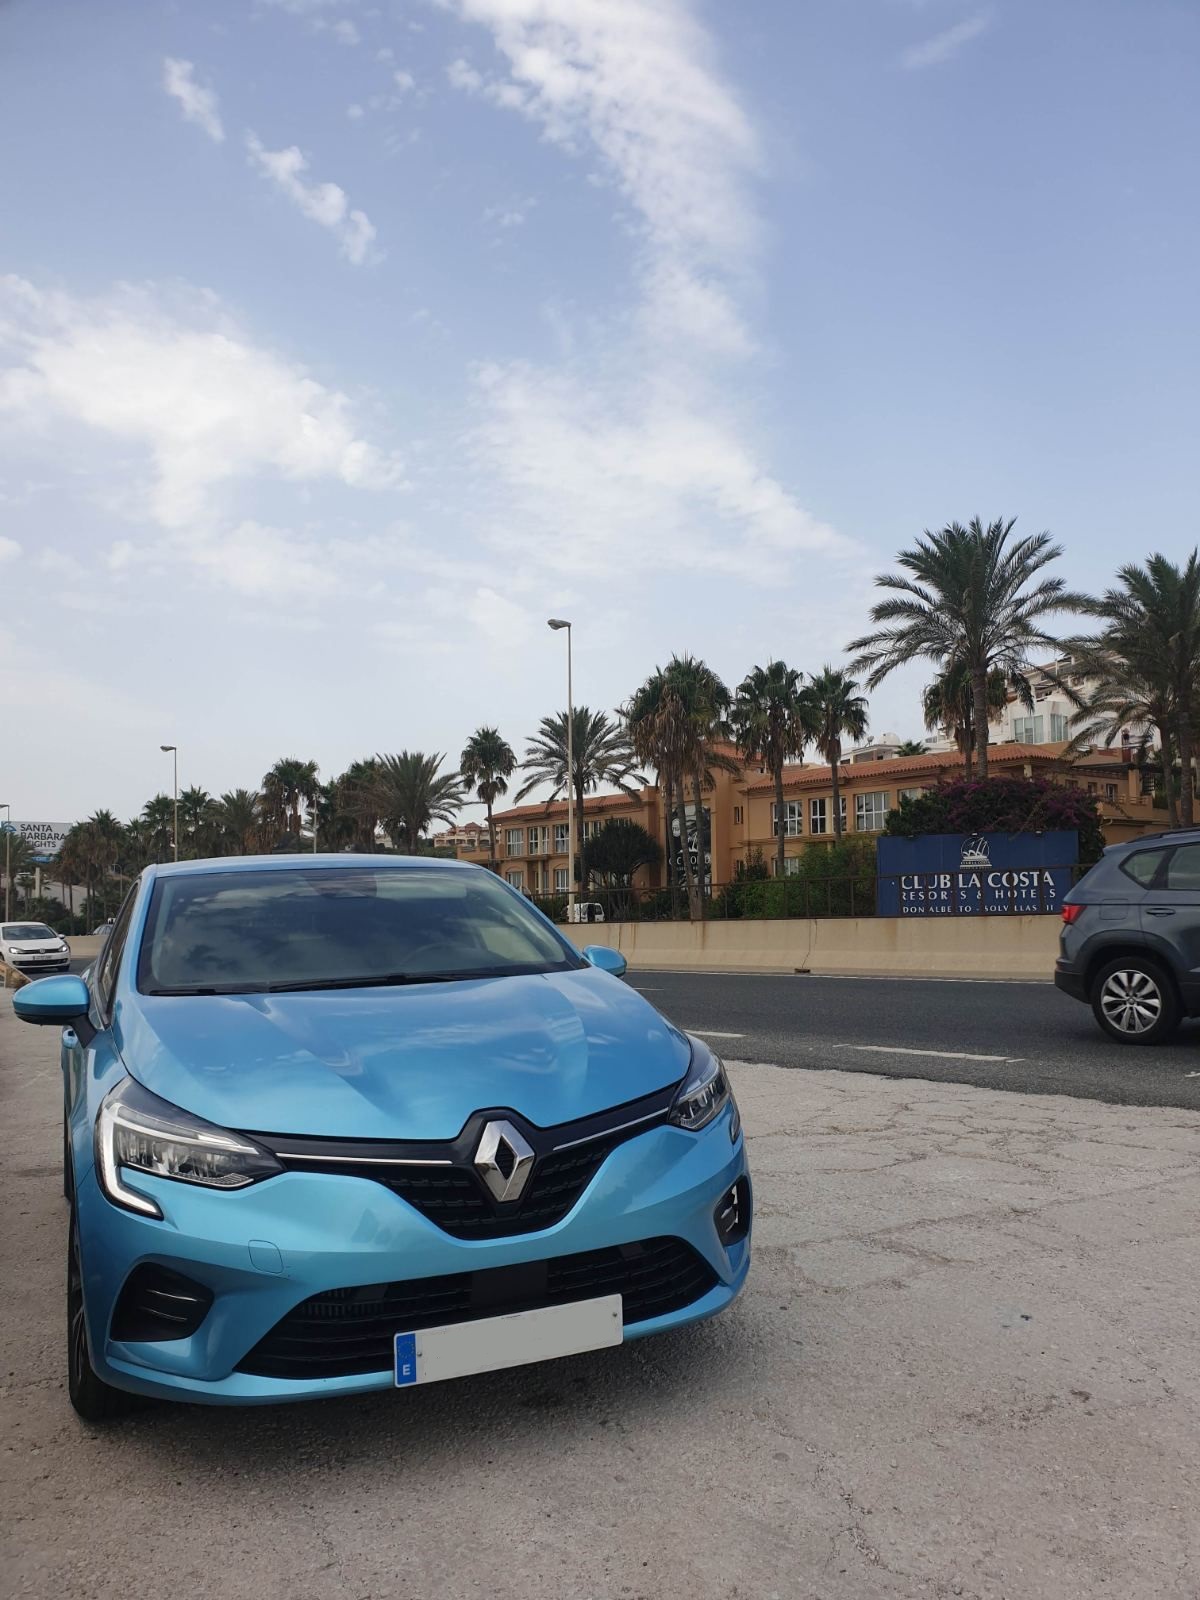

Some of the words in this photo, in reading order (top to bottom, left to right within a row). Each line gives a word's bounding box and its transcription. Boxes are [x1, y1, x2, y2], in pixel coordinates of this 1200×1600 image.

[20, 823, 53, 833] SANTA
[901, 874, 951, 890] CLUB
[958, 873, 981, 888] LA
[987, 871, 1055, 888] COSTA
[902, 890, 967, 901] RESORS
[995, 888, 1056, 899] HOTES
[928, 905, 972, 913] ALBETO
[984, 904, 1038, 912] SOLVLLAS
[402, 1364, 411, 1376] E
